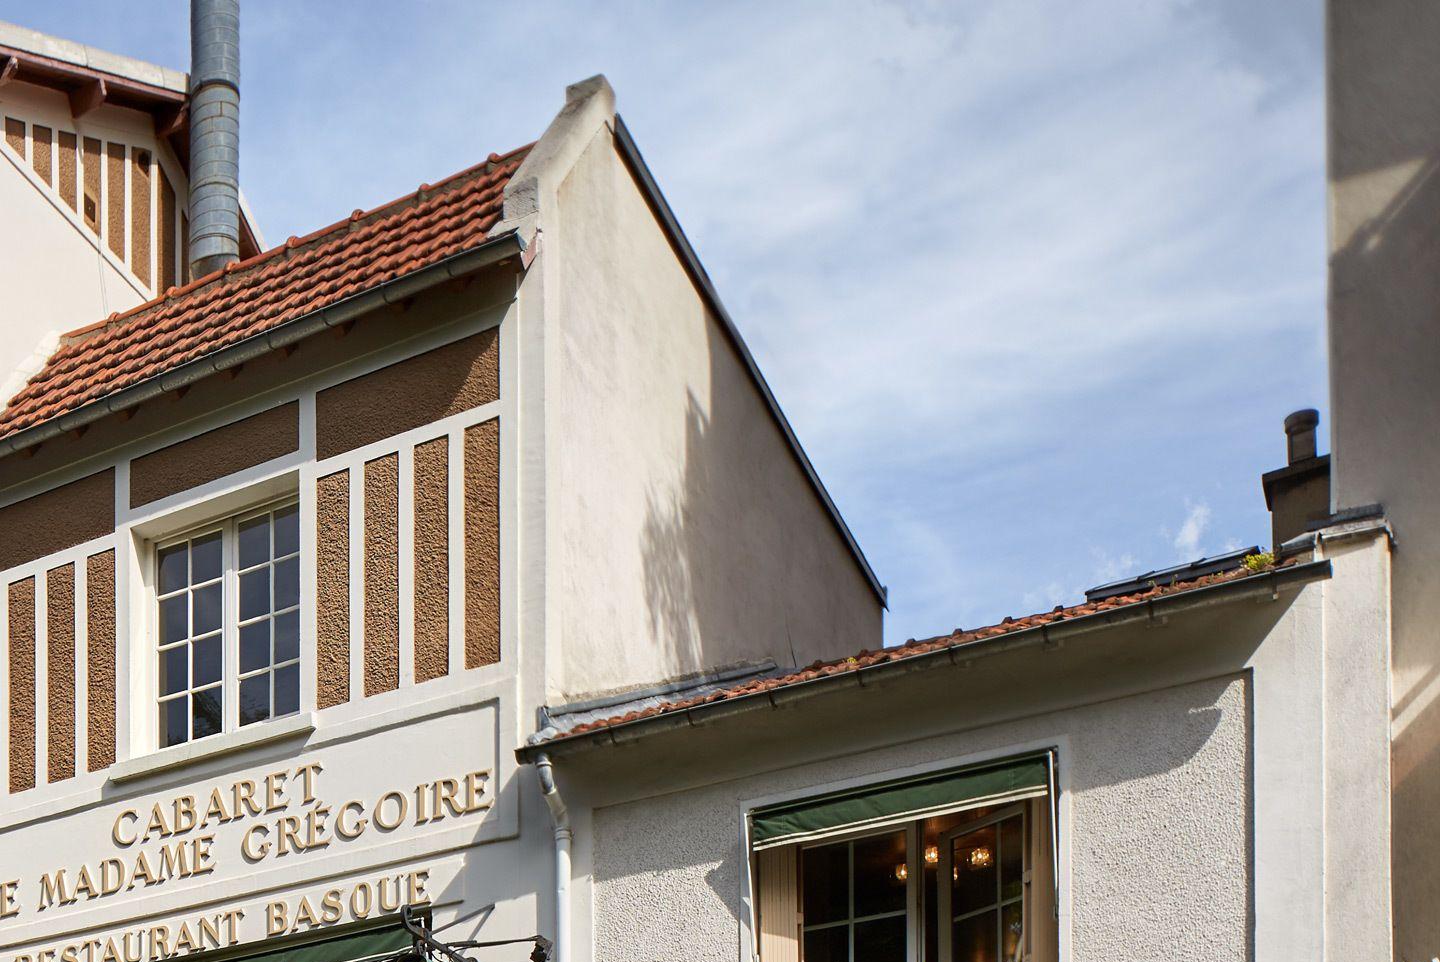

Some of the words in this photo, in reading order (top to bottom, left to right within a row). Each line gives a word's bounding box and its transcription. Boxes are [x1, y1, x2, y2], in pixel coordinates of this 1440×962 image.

[38, 834, 217, 911] MADAME
[241, 768, 496, 863] GRÉGOIRE
[112, 761, 325, 847] CABARET
[266, 868, 433, 936] BASQUE
